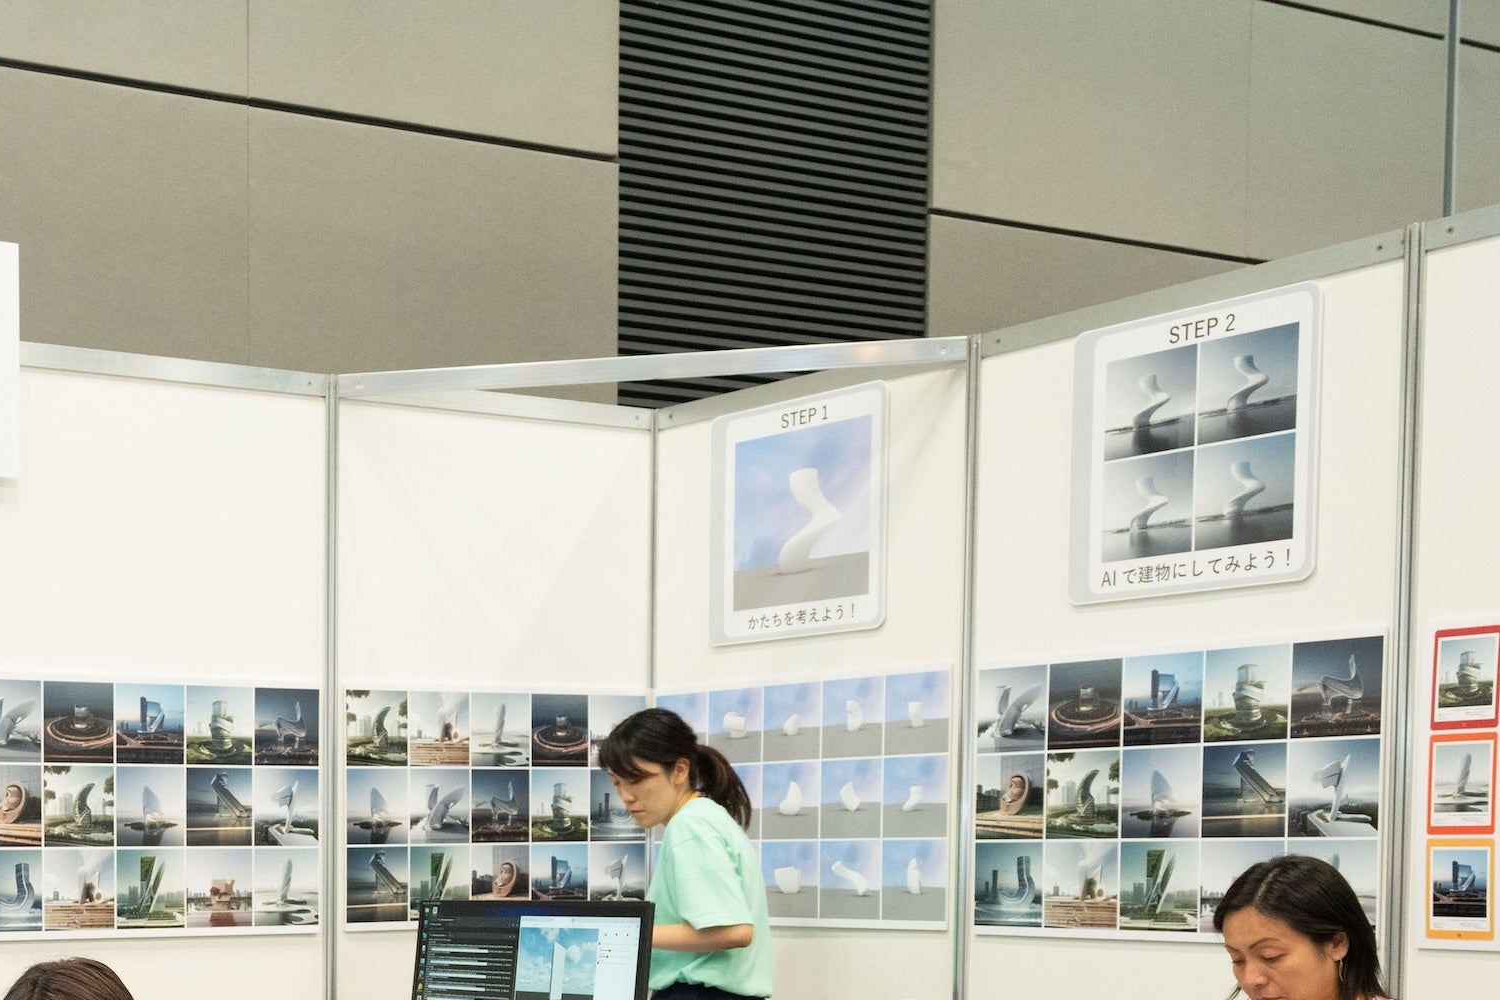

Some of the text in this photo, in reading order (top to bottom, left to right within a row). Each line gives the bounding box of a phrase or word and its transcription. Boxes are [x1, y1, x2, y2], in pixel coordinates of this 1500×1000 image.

[1169, 313, 1237, 345] STEP 2
[780, 404, 830, 431] STEP 1
[747, 602, 856, 632] かたちを考えよう！
